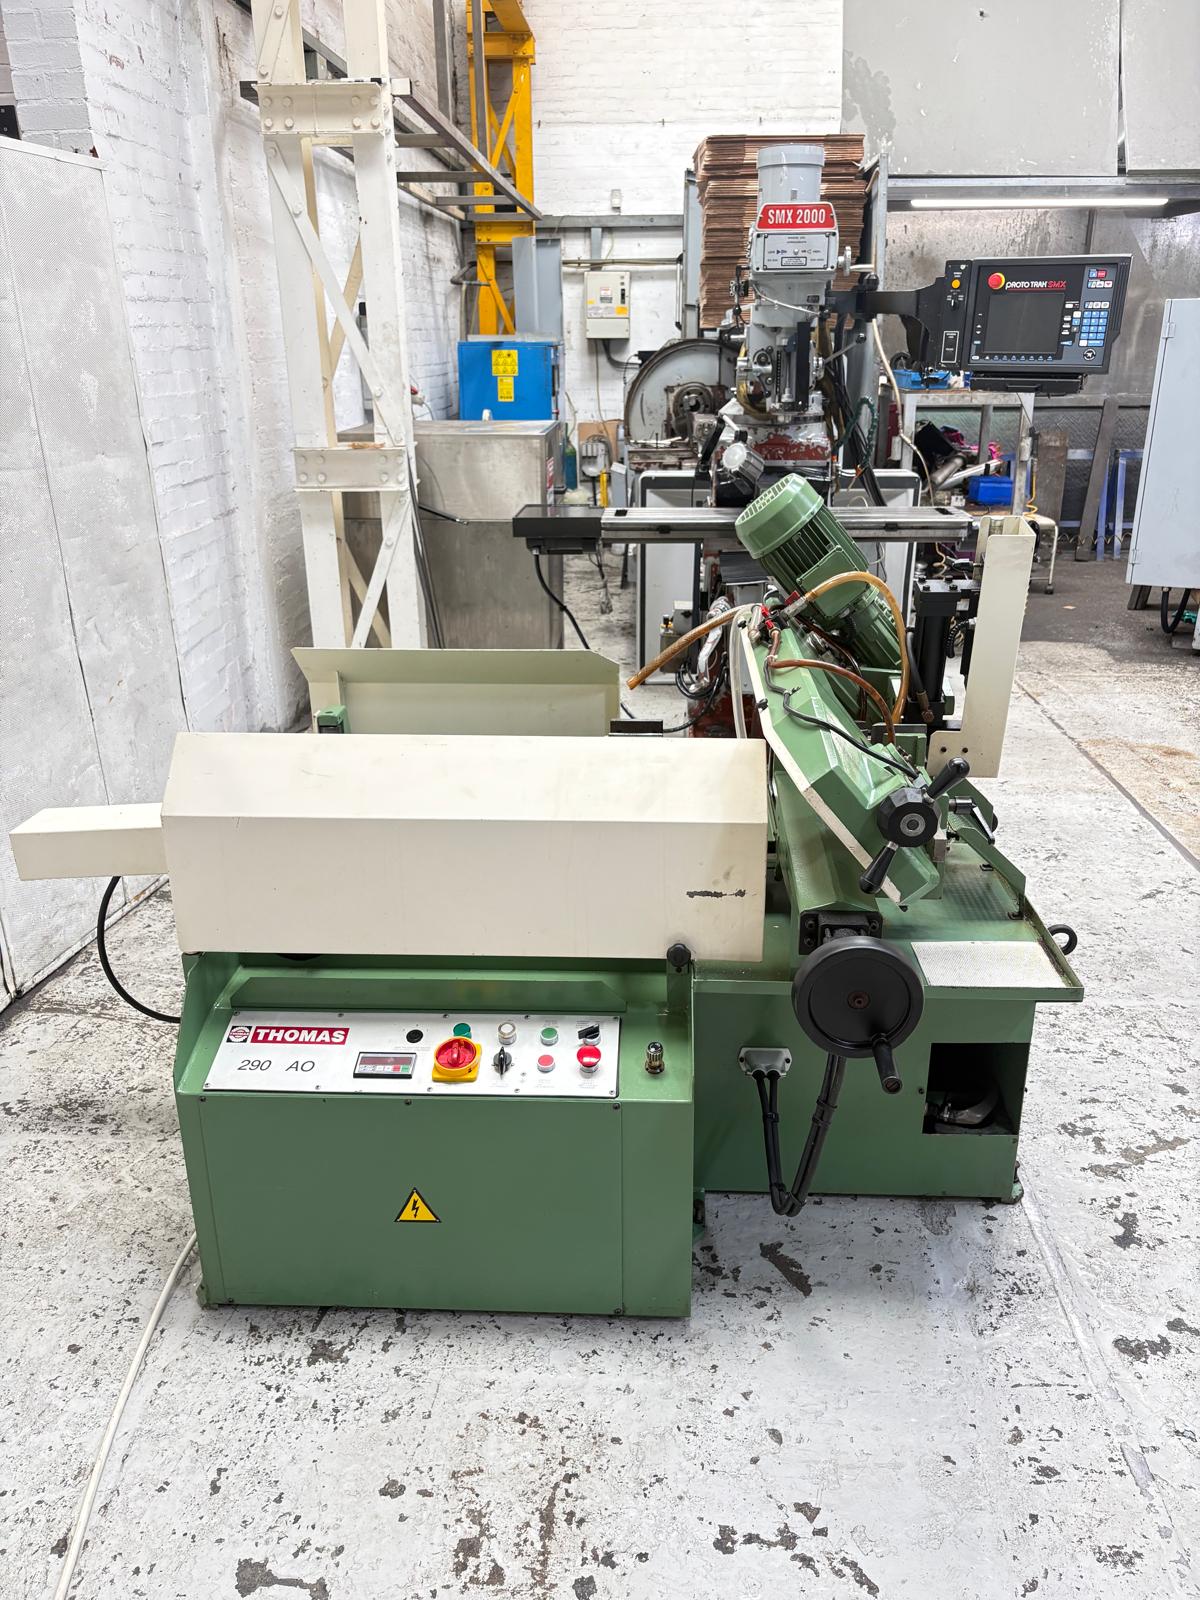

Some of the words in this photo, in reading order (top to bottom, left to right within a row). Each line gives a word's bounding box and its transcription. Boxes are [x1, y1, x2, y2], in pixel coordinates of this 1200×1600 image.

[768, 209, 793, 224] SMX
[796, 209, 826, 224] 2000
[1047, 280, 1066, 288] SMX
[256, 1029, 346, 1042] THOMAS
[237, 1060, 272, 1071] 290
[285, 1061, 315, 1072] AO
